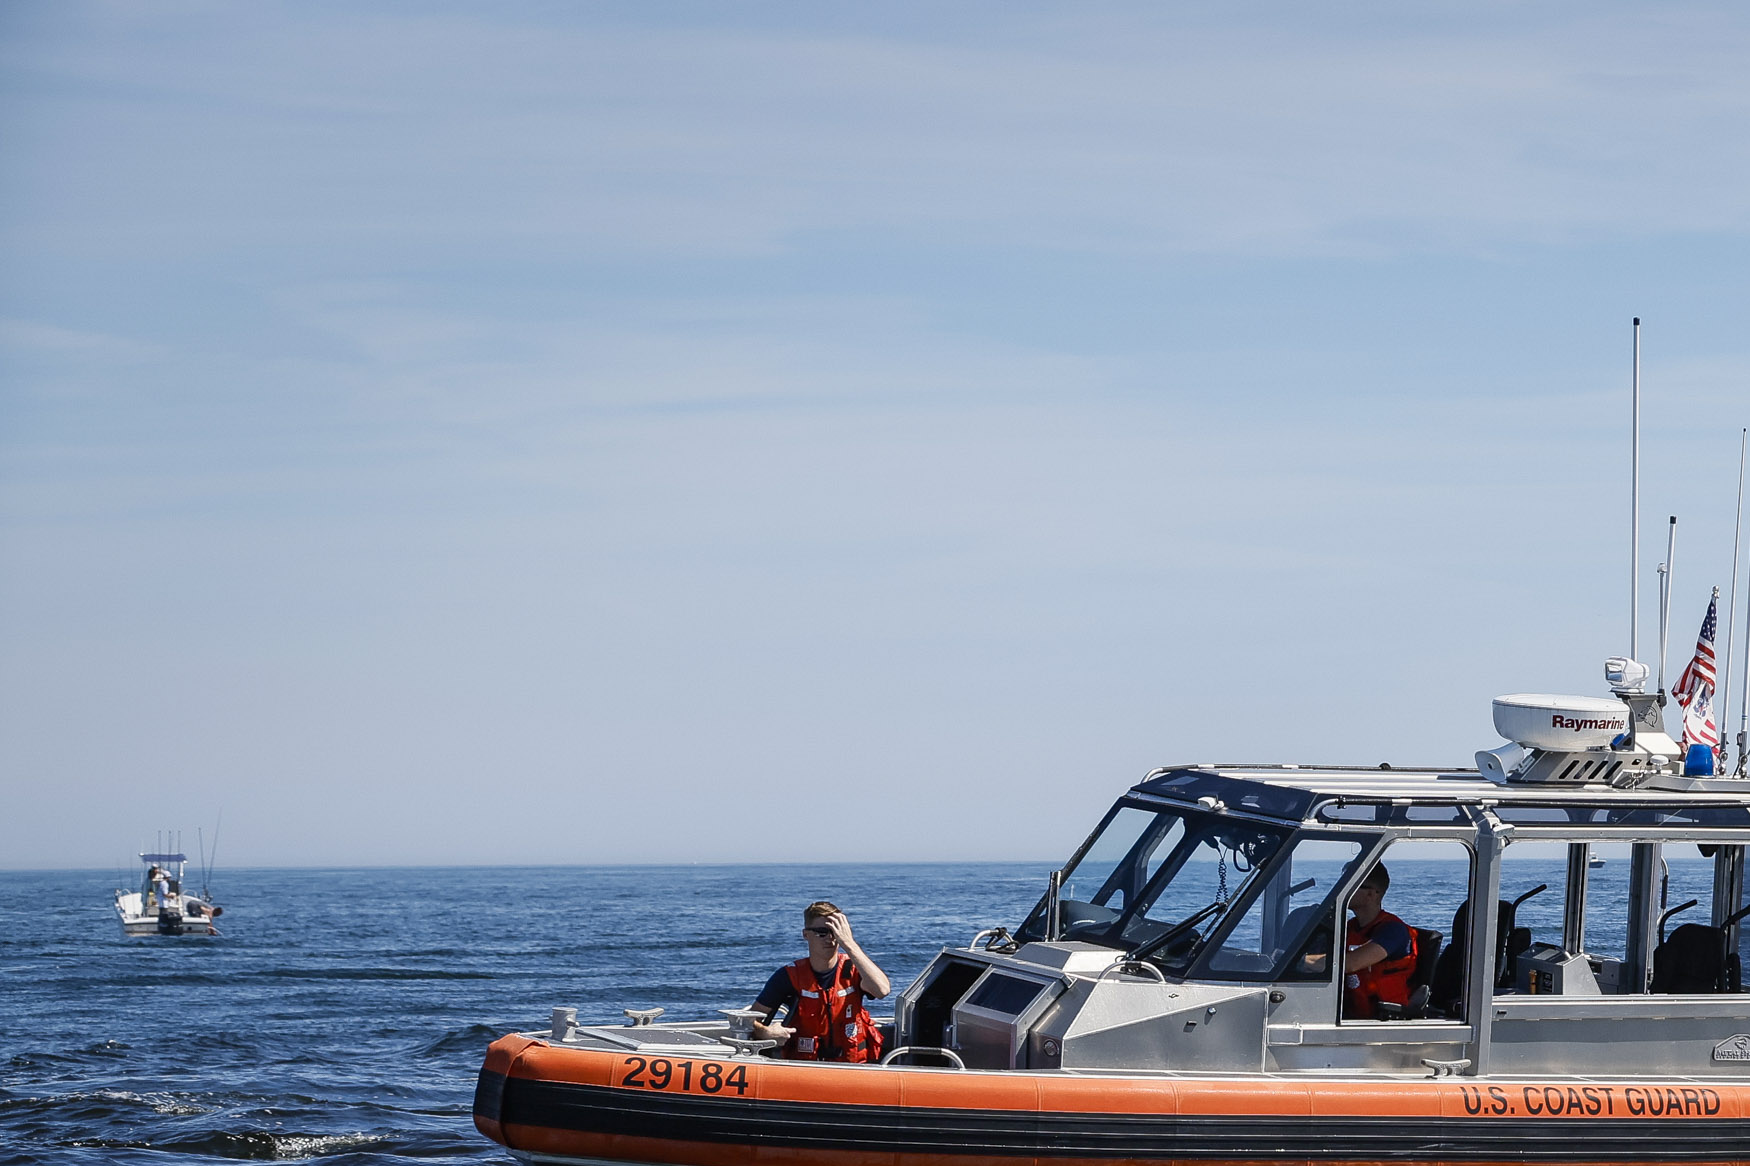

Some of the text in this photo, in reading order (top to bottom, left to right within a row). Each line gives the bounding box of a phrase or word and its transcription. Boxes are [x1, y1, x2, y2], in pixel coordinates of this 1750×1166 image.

[1552, 714, 1625, 732] Raymarine
[621, 1056, 749, 1096] 29184
[1459, 1086, 1722, 1116] U.S. COAST GUARD
